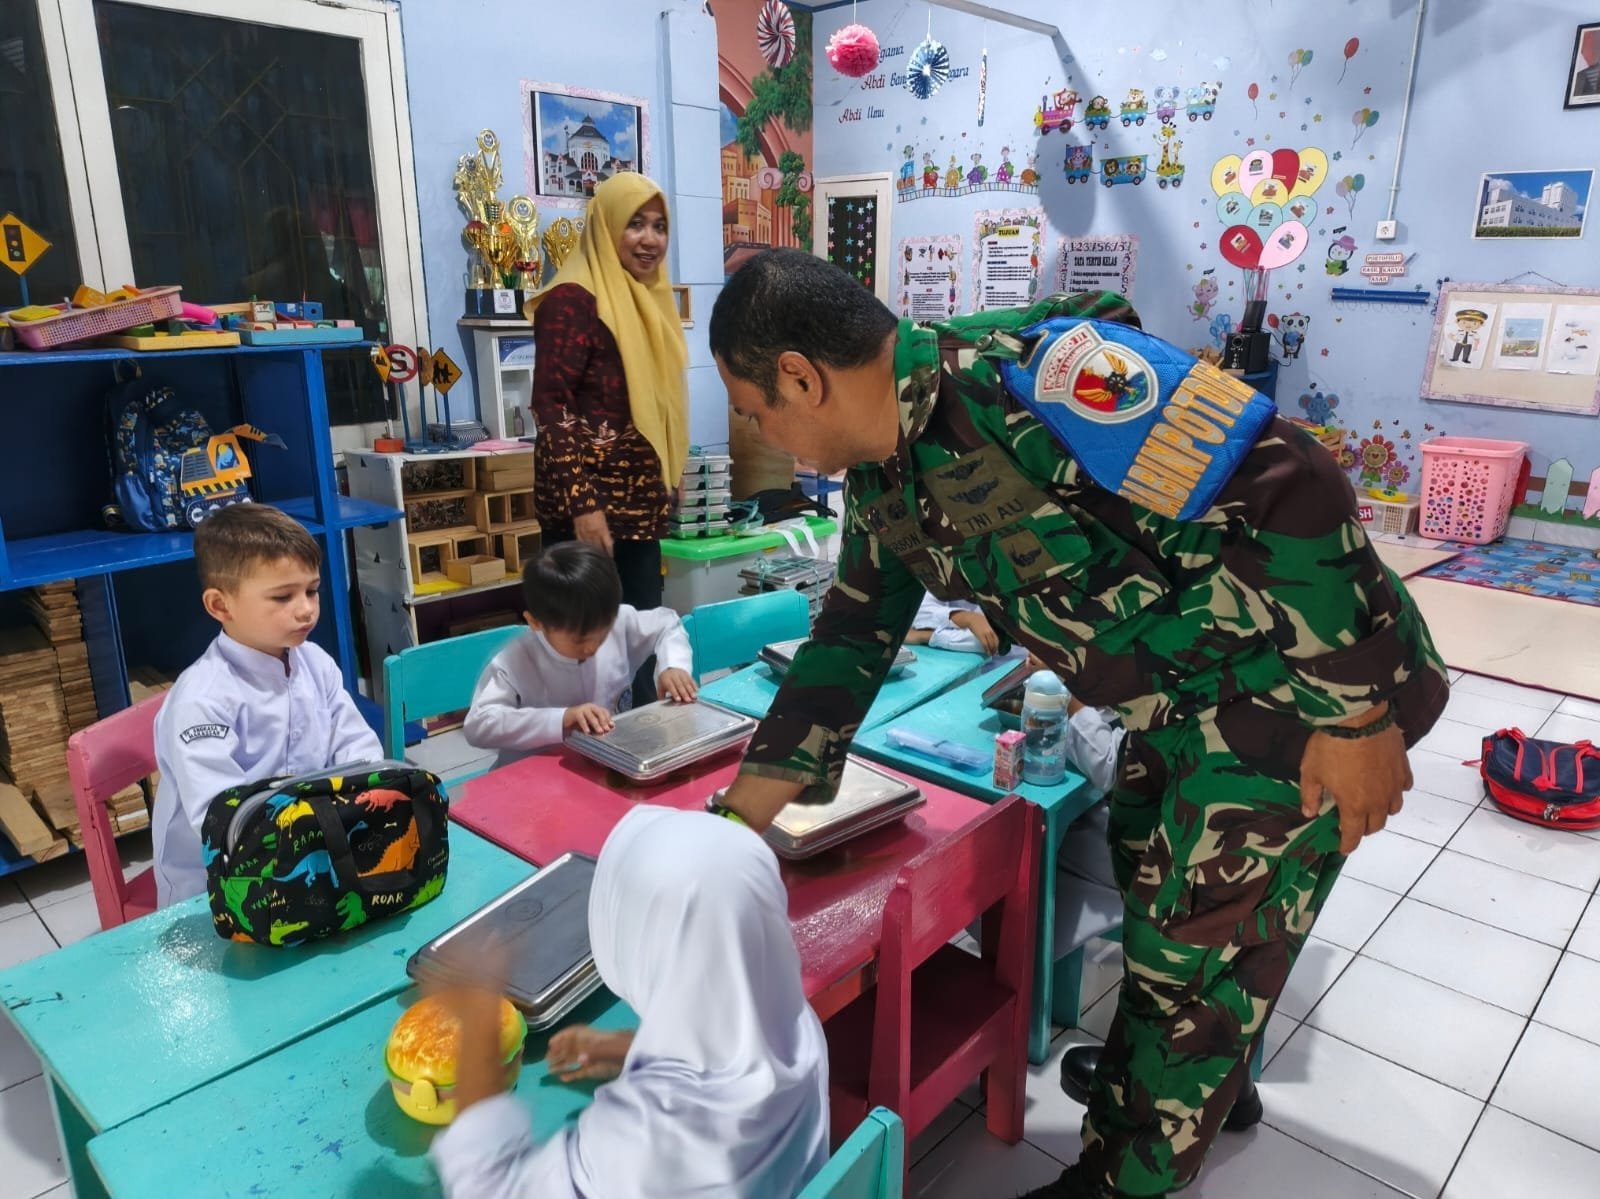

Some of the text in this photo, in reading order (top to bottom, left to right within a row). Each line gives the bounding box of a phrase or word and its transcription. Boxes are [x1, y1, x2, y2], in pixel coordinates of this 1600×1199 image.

[879, 45, 905, 63] gama
[860, 75, 886, 91] Abdi
[838, 108, 862, 124] Abdi
[966, 498, 1025, 532] TNI AU
[371, 891, 404, 907] ROAR
